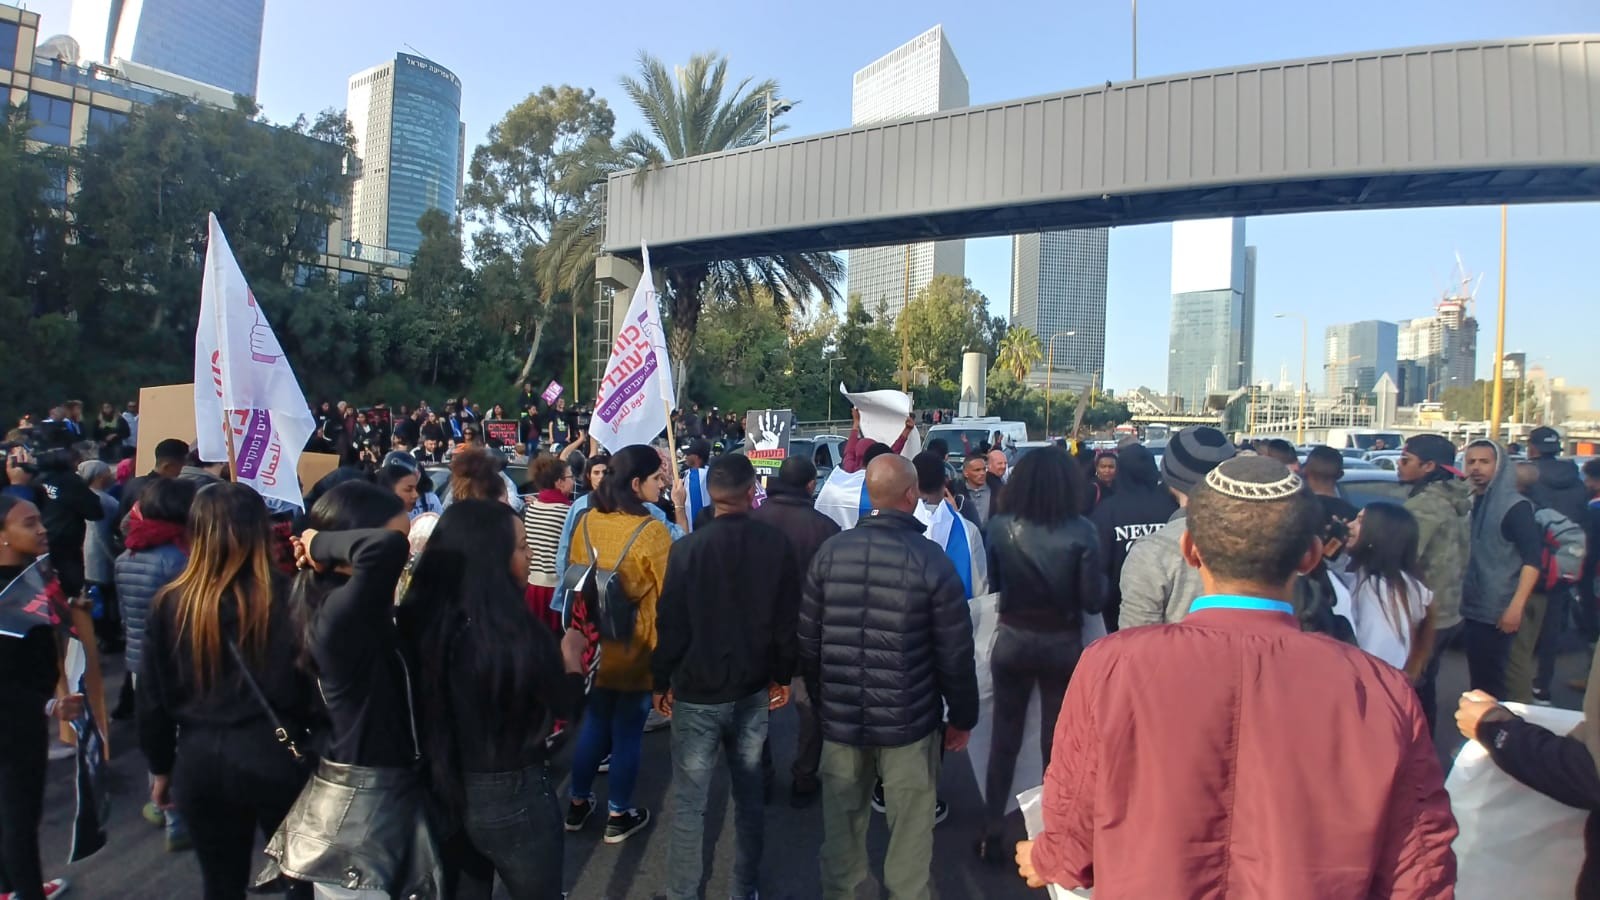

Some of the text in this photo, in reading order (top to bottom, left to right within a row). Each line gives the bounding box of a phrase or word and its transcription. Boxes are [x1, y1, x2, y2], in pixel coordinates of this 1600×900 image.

[406, 57, 428, 69] ישראל
[241, 433, 264, 473] דמוקרטי
[260, 442, 281, 487] للعمال
